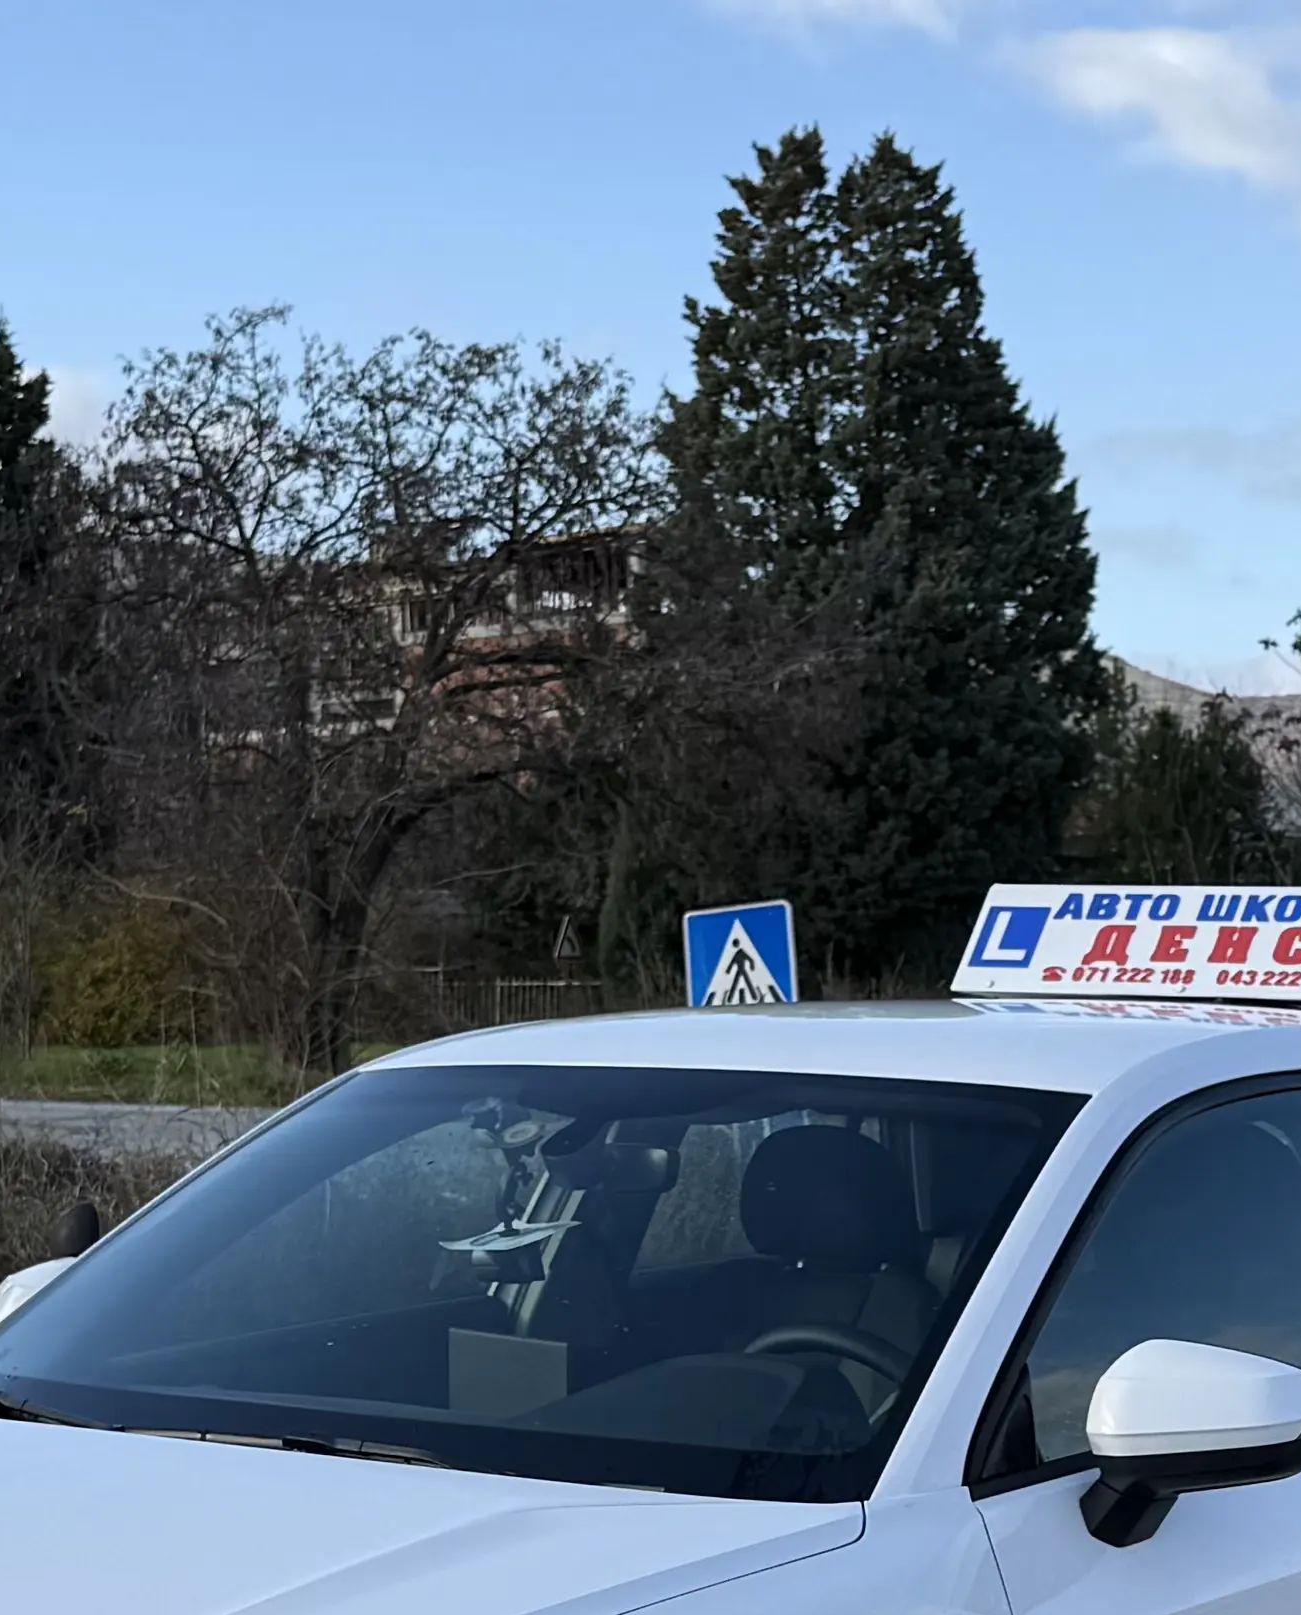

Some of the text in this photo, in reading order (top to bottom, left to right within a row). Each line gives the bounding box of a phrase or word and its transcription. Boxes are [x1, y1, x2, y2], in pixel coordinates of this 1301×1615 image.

[1052, 893, 1182, 921] АВТО
[981, 910, 1028, 961] L
[1112, 967, 1157, 984] 222
[1160, 968, 1197, 985] 188
[1215, 969, 1259, 987] 043
